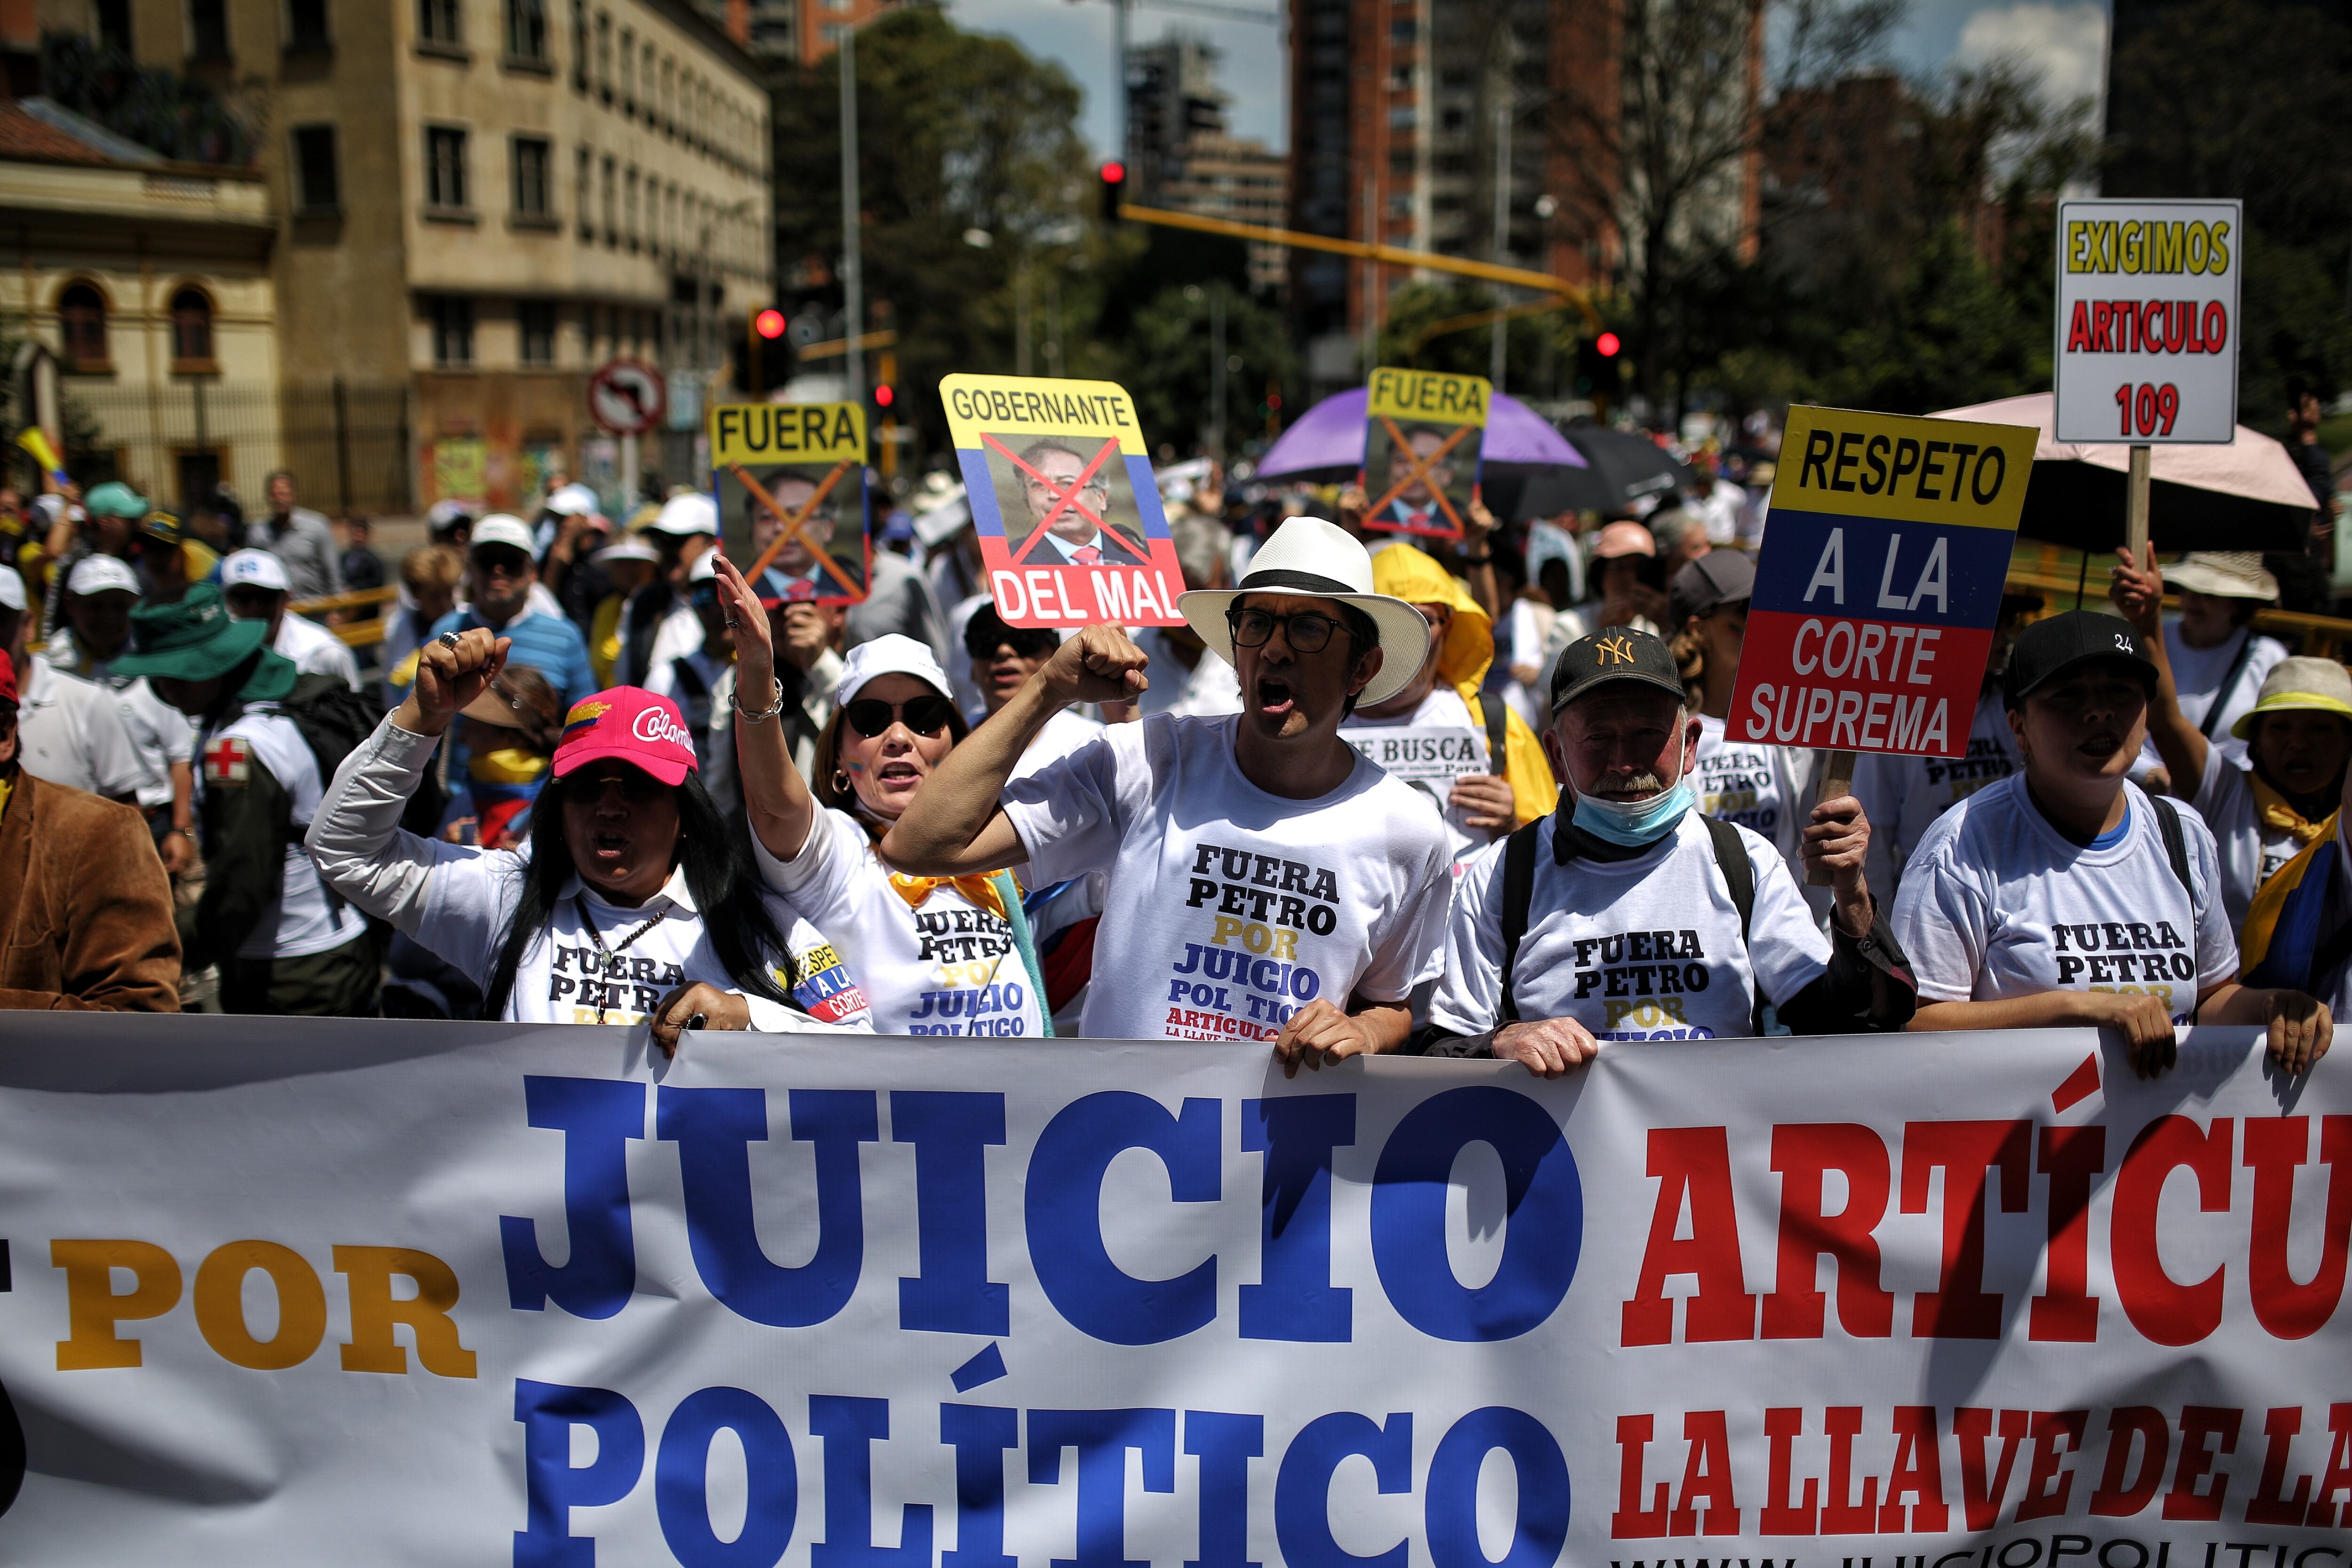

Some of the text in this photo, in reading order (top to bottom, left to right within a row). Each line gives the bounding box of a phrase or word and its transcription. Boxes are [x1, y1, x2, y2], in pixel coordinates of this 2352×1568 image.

[2067, 220, 2231, 275] EXIGIMOS
[2066, 300, 2227, 355] ARTICULO
[952, 388, 1130, 427] GOBERNANTE
[1375, 372, 1483, 415] FUERA
[2115, 382, 2179, 437] 109
[718, 406, 858, 453] FUERA
[1799, 429, 2006, 506] RESPETO
[1804, 527, 1947, 613] A LA
[992, 569, 1185, 620] DEL MAL
[1595, 635, 1635, 666] NY
[1792, 619, 1942, 685] CORTE
[2114, 634, 2133, 654] 24
[632, 705, 696, 757] Colom
[1746, 682, 1948, 753] SUPREMA
[1383, 737, 1477, 762] BUSCA
[1700, 753, 1767, 772] UERA
[1700, 772, 1771, 792] ETRO
[1703, 791, 1760, 814] POR
[1192, 844, 1340, 904] FUERA
[1185, 877, 1337, 936] PETRO
[1211, 915, 1299, 961] POR
[1573, 930, 1705, 968] FUERA
[2051, 921, 2186, 952] FUERA
[553, 943, 687, 986] FUERA
[815, 966, 854, 997] A LA
[1173, 942, 1319, 1001] JUICIO
[1574, 963, 1709, 999] PETRO
[2056, 953, 2195, 984] PETRO
[549, 974, 660, 1013] PETR
[828, 989, 867, 1017] CORTE
[1603, 996, 1688, 1029] POR
[1165, 1026, 1181, 1037] LA
[500, 1075, 1583, 1345] JUICIO
[1621, 1051, 2352, 1346] ARTÍCU
[50, 1240, 477, 1379] POR
[513, 1341, 1571, 1568] POLÍTICO
[1611, 1402, 2352, 1539] LA LLAVE DE LA
